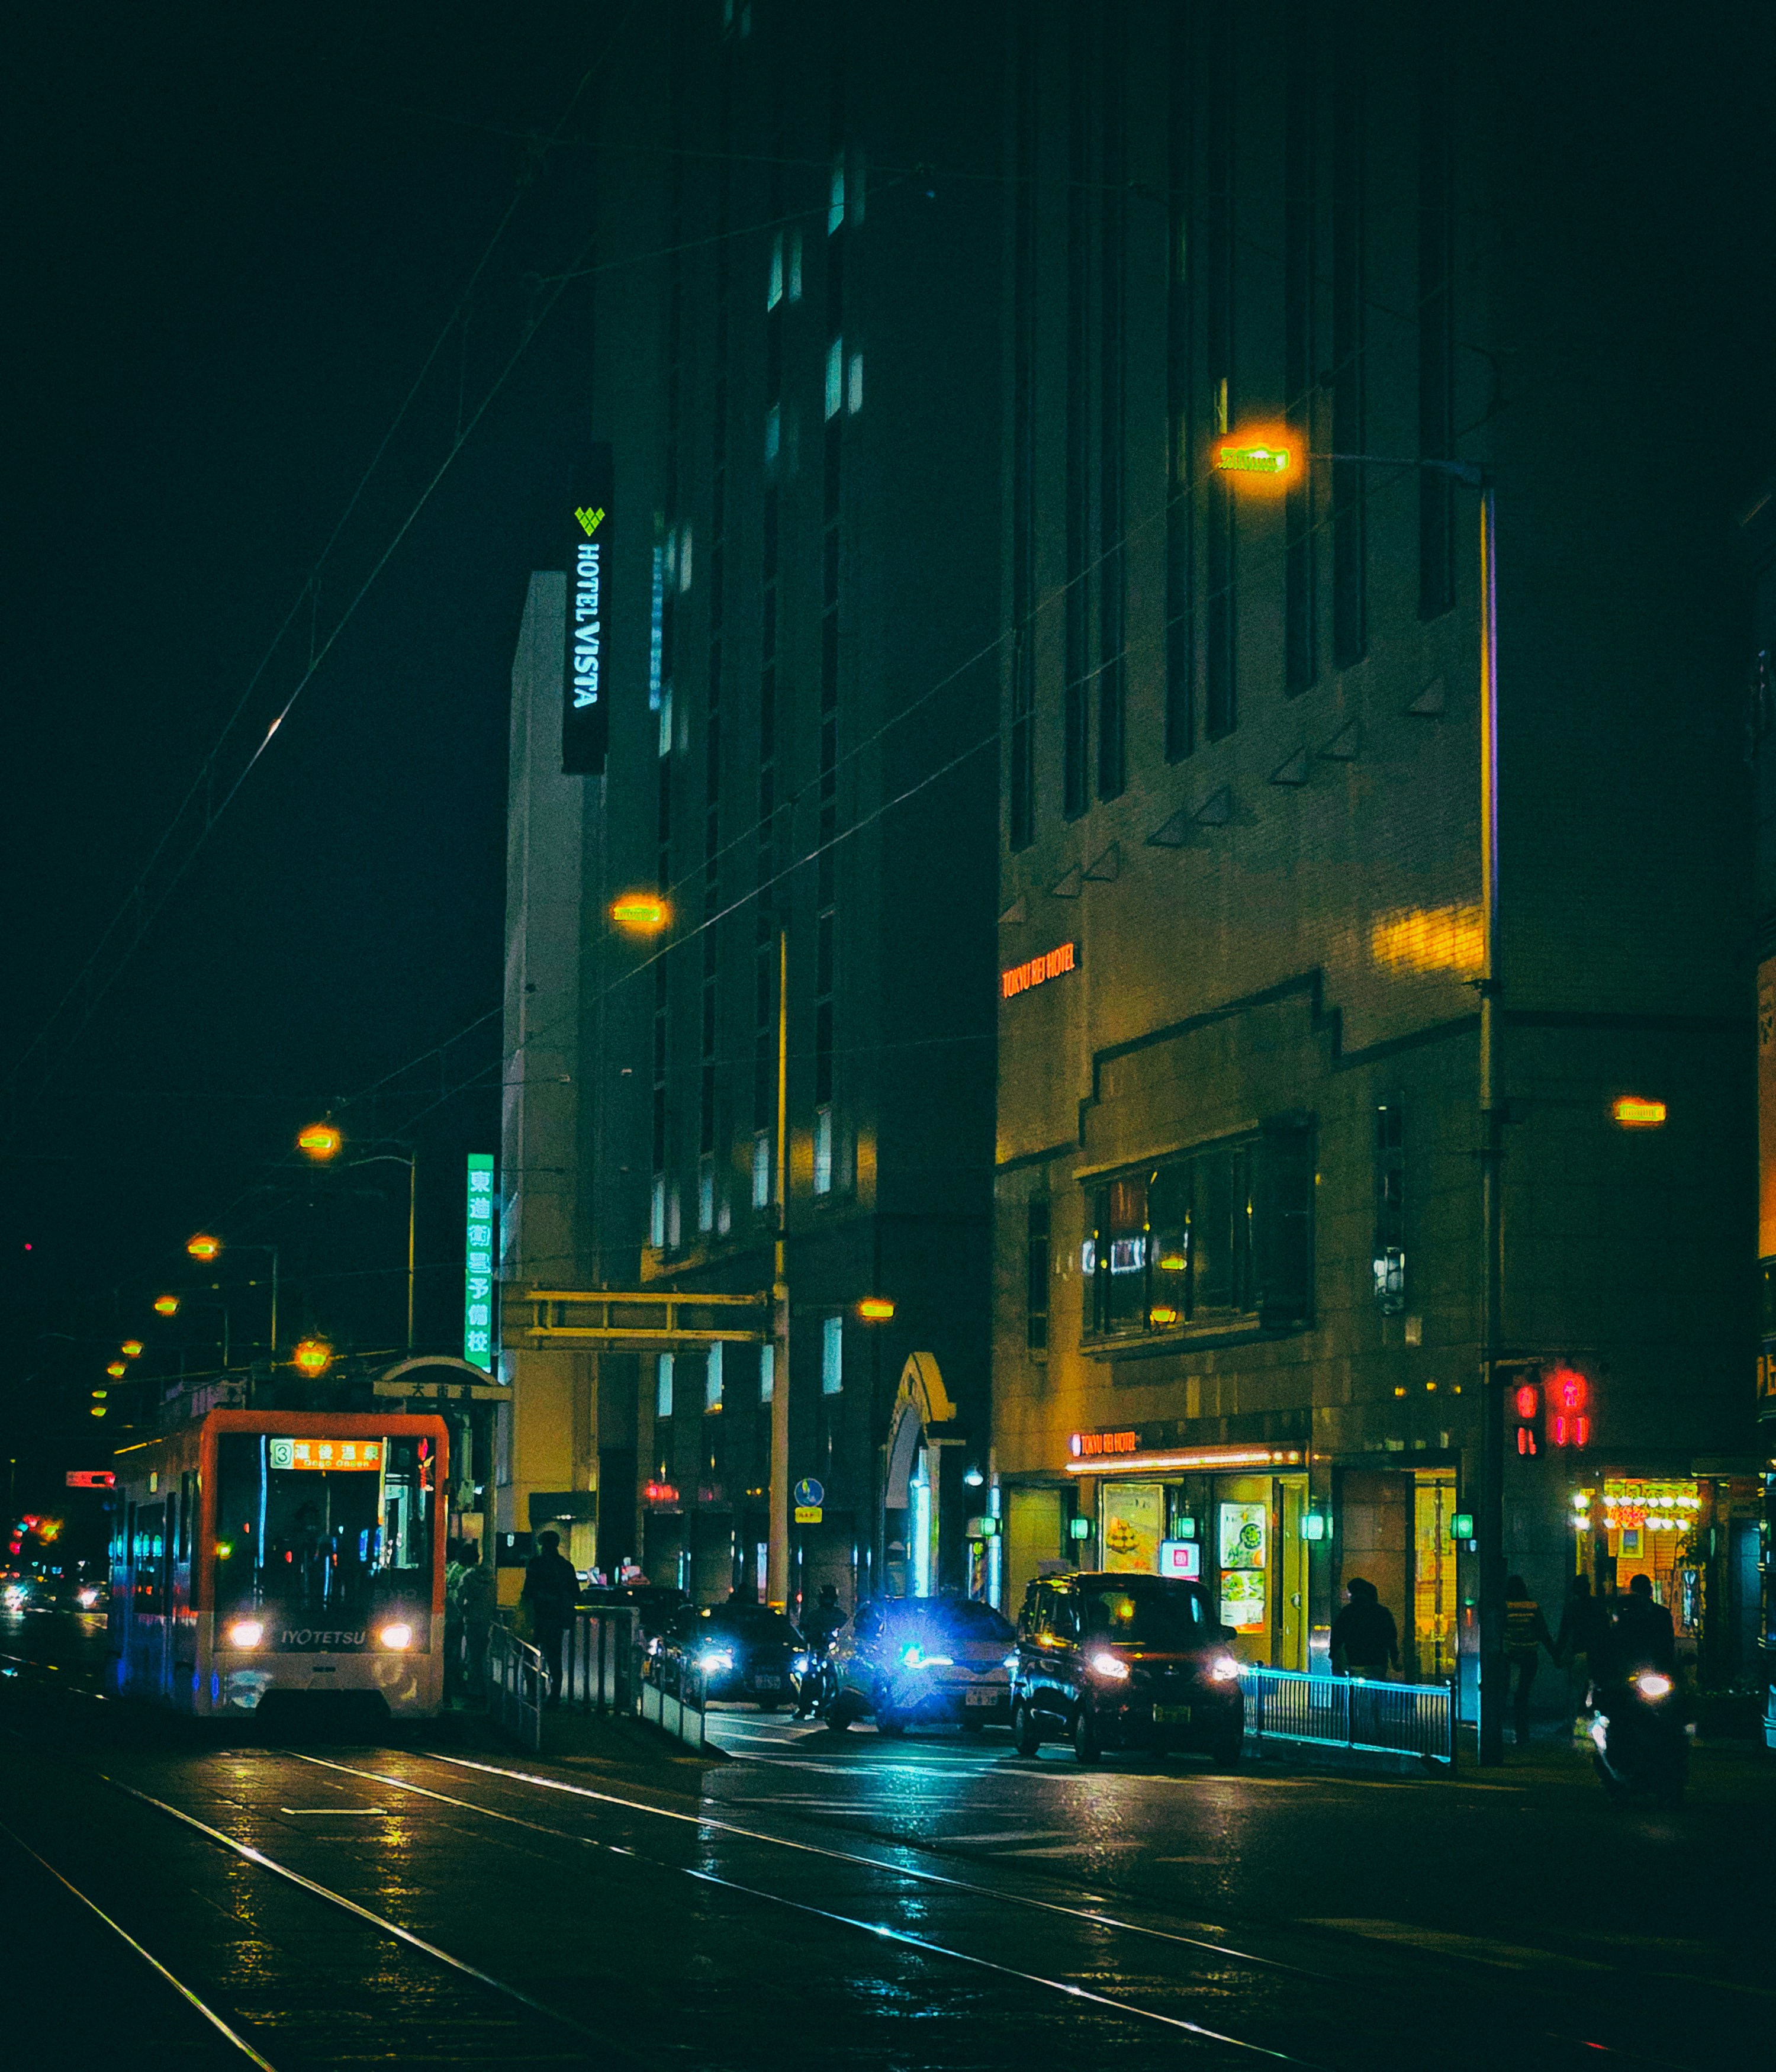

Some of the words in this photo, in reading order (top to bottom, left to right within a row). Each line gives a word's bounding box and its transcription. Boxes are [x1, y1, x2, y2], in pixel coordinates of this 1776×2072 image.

[575, 543, 600, 622] HOTEL
[573, 621, 600, 709] VISTA
[1046, 942, 1075, 980] HOTEL
[277, 1446, 288, 1463] 3
[281, 1629, 366, 1645] IYOTETSU
